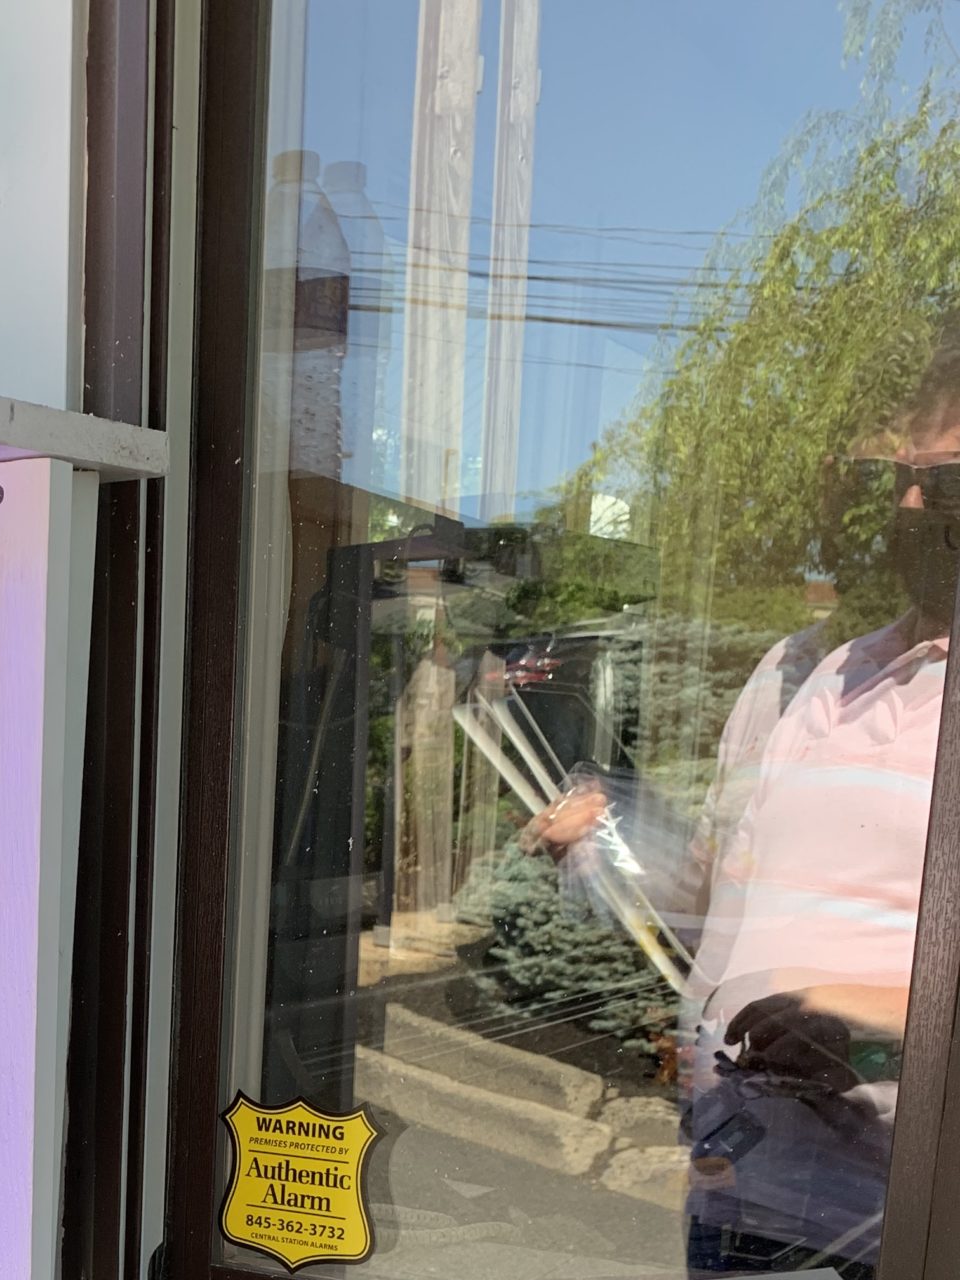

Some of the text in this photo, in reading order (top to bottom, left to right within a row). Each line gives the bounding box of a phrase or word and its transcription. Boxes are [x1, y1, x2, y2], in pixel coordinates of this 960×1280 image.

[255, 1116, 345, 1141] WARNING
[248, 1136, 350, 1156] PREMISES PROTECTED BY
[245, 1156, 352, 1191] Authentic
[261, 1183, 332, 1213] Alarm
[245, 1214, 345, 1241] 845-362-3732
[250, 1232, 339, 1252] CENTRAL STATION ALARMS
